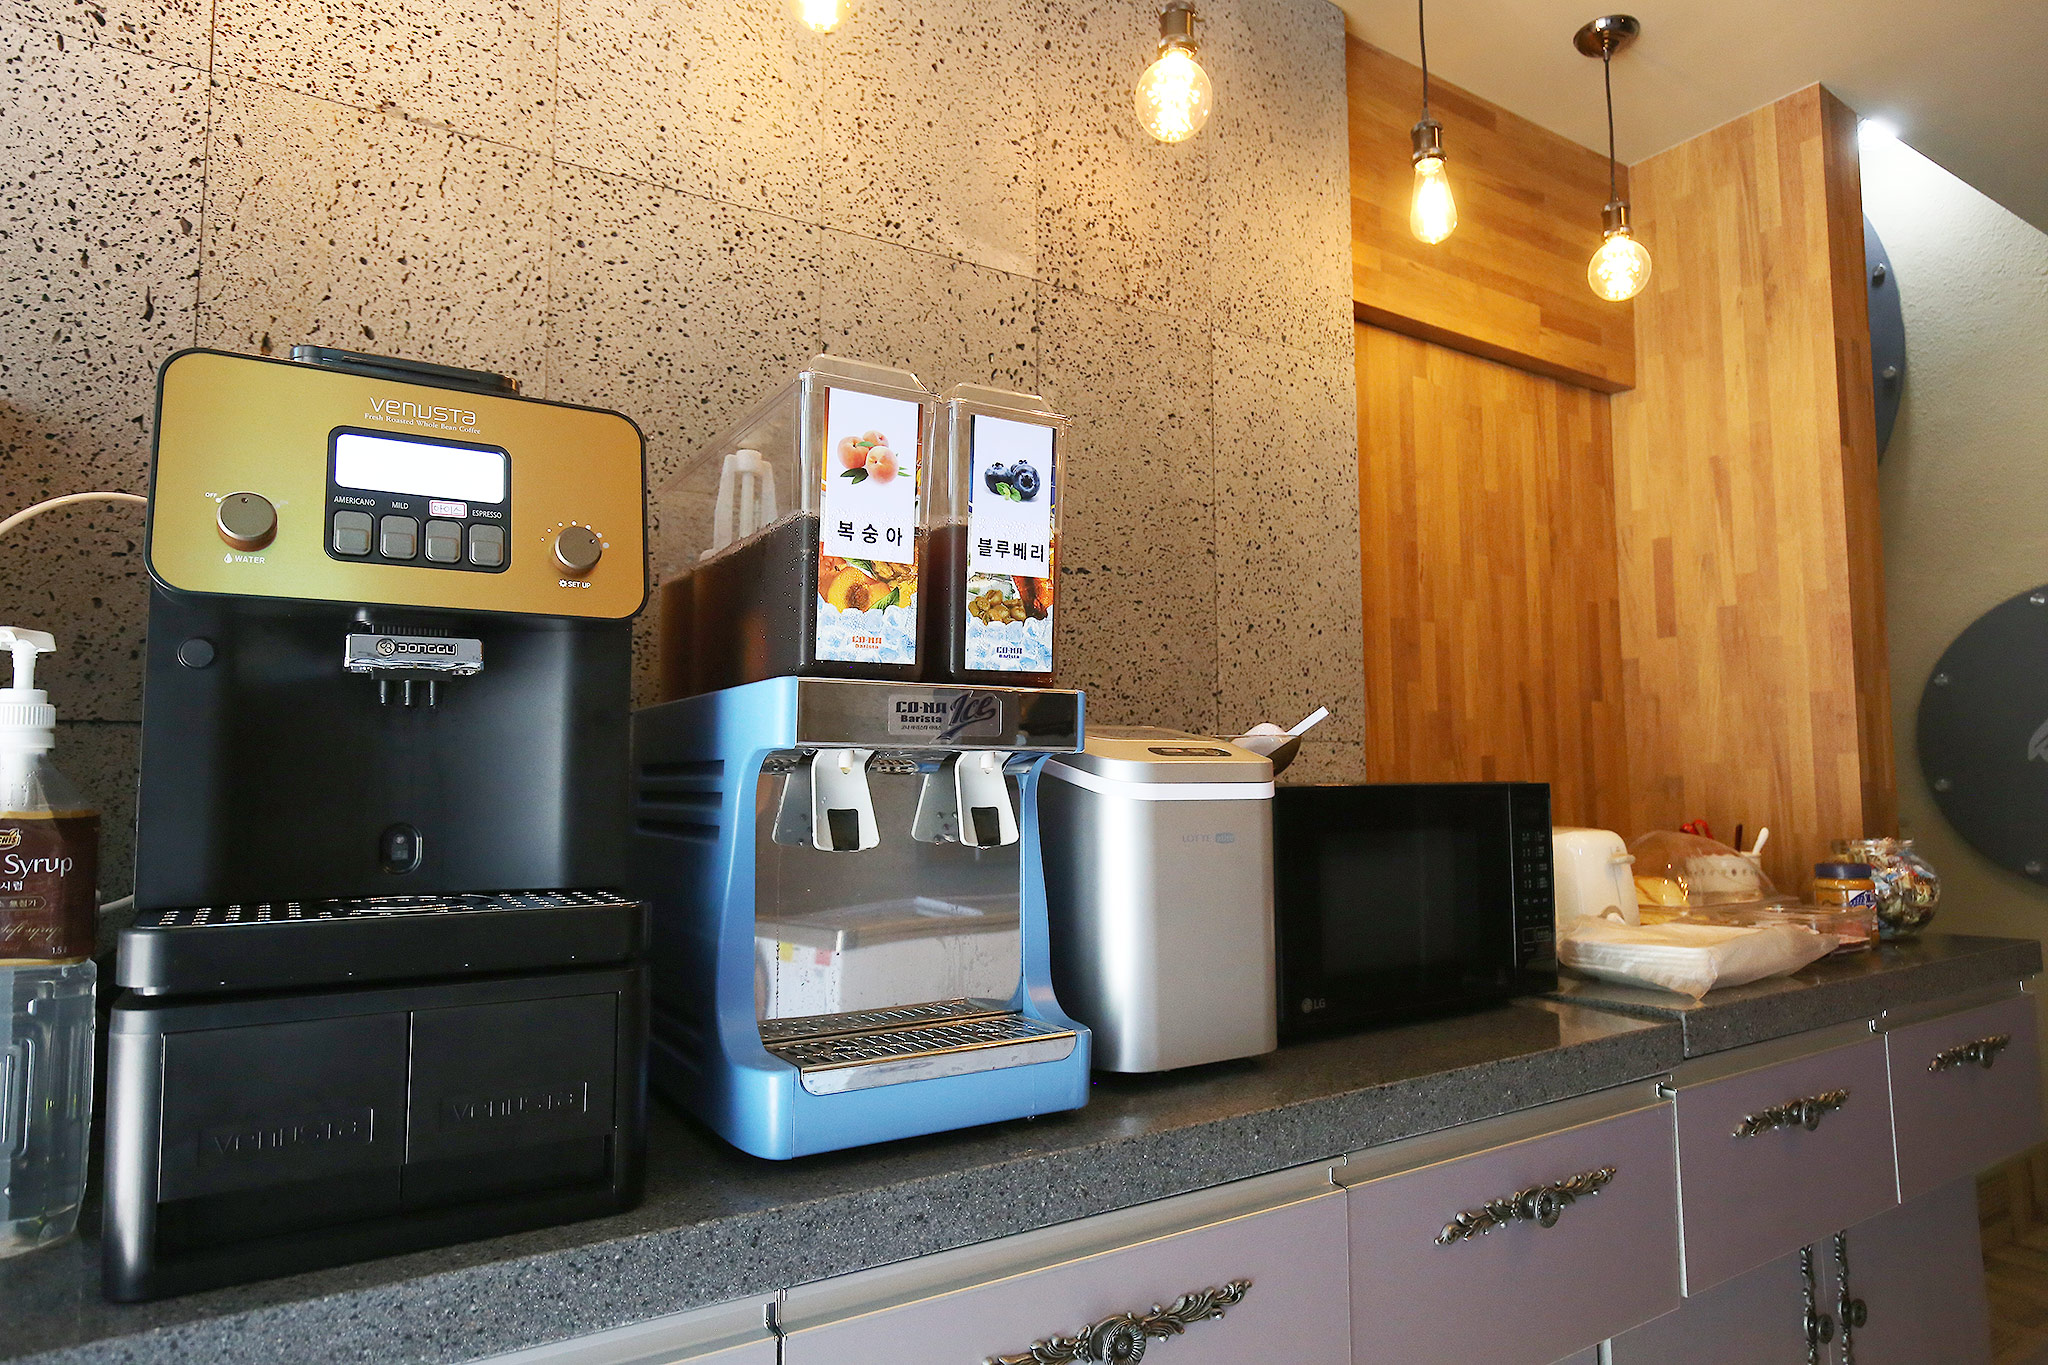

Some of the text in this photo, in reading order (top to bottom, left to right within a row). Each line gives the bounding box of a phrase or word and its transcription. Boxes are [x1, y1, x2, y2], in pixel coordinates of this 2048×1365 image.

[364, 413, 481, 435] Fresh Roasted Whole Bean Coffee
[333, 495, 376, 506] AMERICANO
[392, 502, 409, 510] MILD
[472, 509, 503, 519] ESPRESSO
[837, 520, 903, 546] 복숭아
[977, 537, 1044, 562] 블루베리
[234, 555, 265, 564] WATER
[945, 691, 997, 732] Ice
[900, 715, 942, 723] Barista
[4, 853, 73, 879] Syrup
[1313, 998, 1326, 1009] LG
